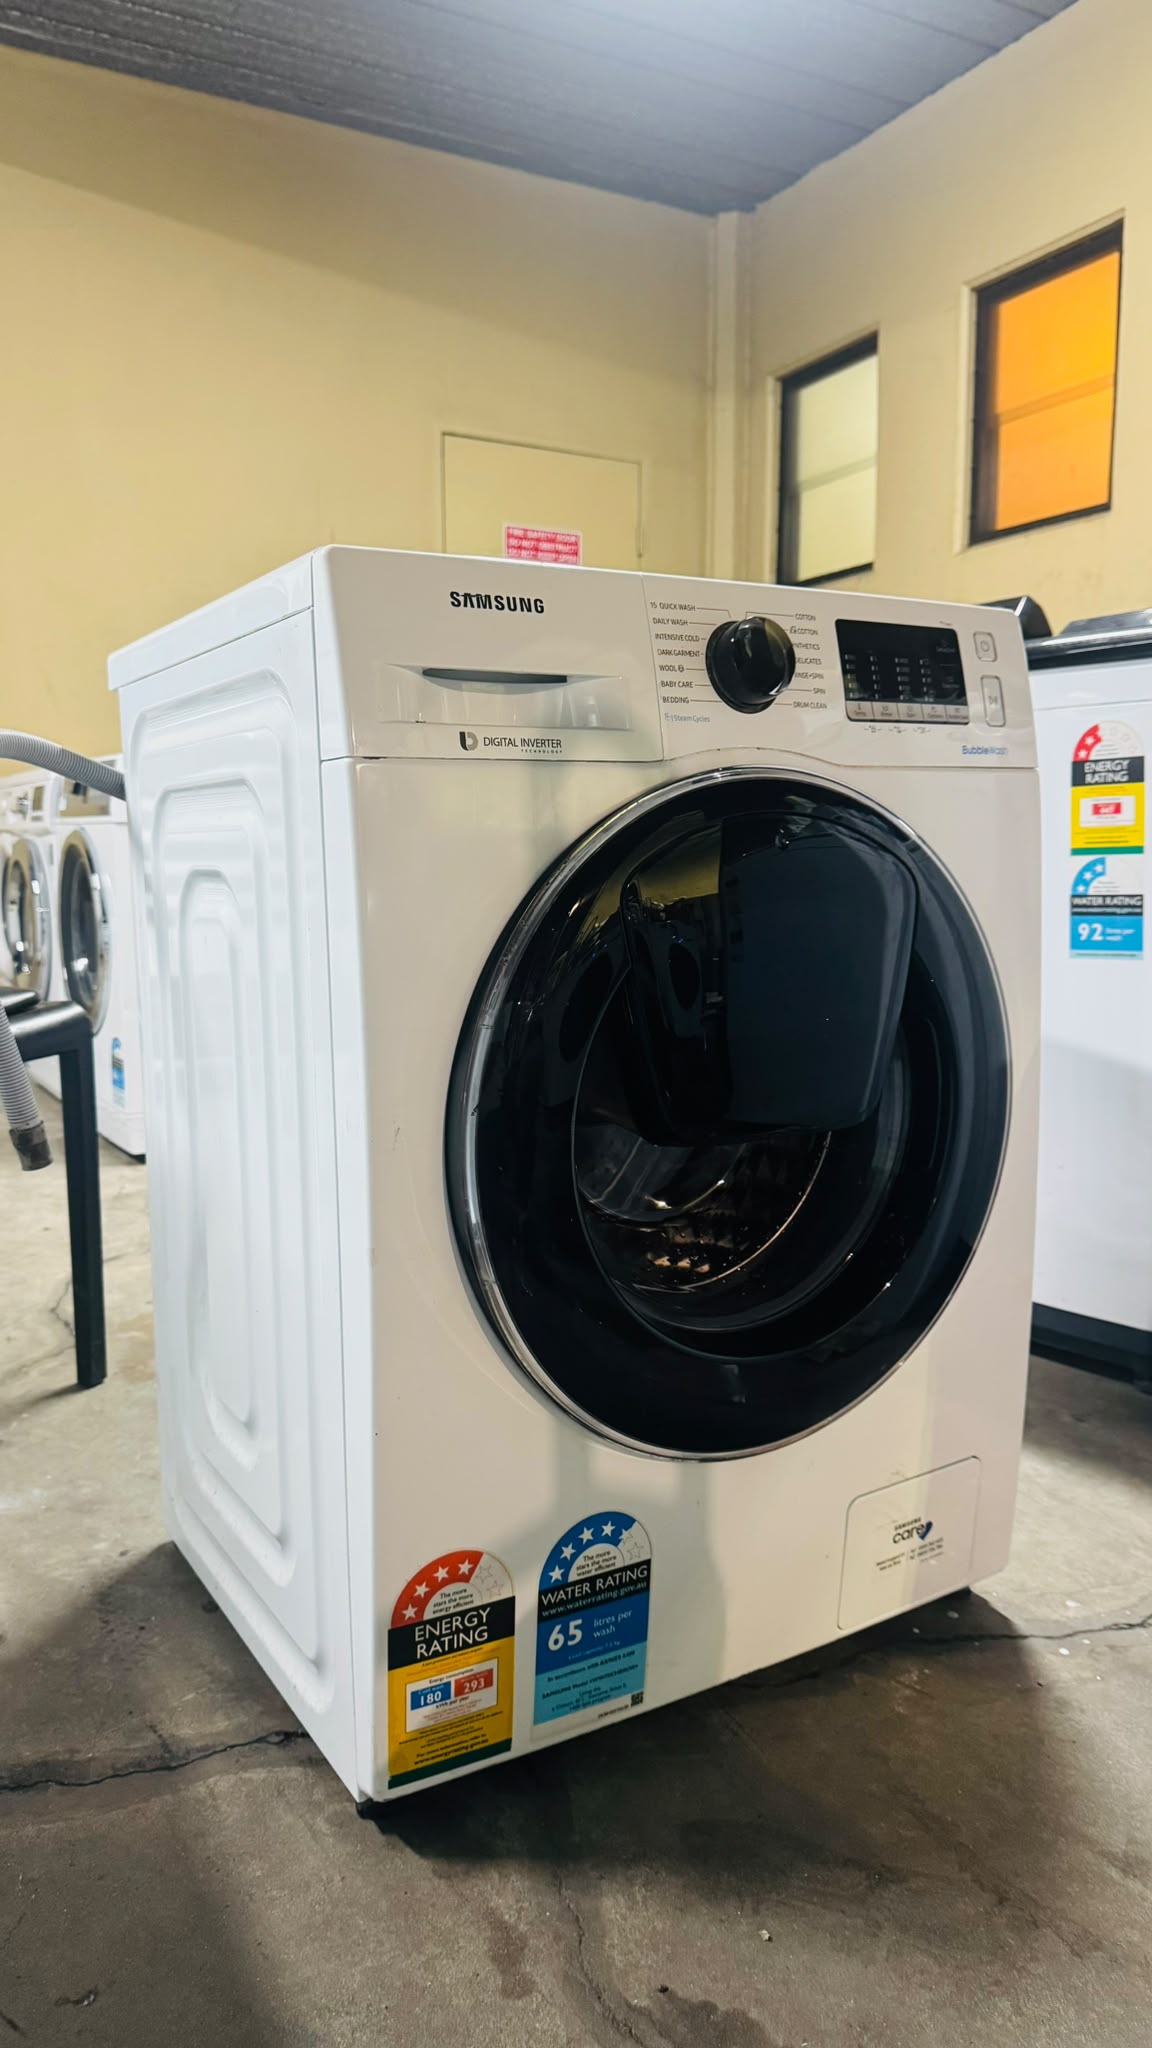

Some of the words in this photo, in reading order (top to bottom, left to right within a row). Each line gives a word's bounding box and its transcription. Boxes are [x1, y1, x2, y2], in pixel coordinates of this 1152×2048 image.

[450, 591, 545, 613] SAMSUNG
[795, 613, 817, 621] COTTON
[655, 633, 683, 641] INTENSIVE
[483, 737, 519, 748] DIGITAL
[520, 738, 563, 749] INVERTER
[1084, 759, 1130, 773] ENERGY
[1085, 771, 1129, 784] RATING
[1072, 896, 1104, 906] WATER
[1105, 896, 1143, 906] RATING
[1078, 923, 1104, 941] 92
[893, 1524, 926, 1543] care
[583, 1554, 595, 1562] The
[595, 1550, 611, 1559] more
[602, 1556, 617, 1565] more
[576, 1570, 593, 1578] water
[594, 1562, 616, 1573] efficient
[541, 1581, 592, 1606] WATER
[596, 1565, 649, 1592] RATING
[433, 1600, 447, 1608] stars
[459, 1593, 474, 1602] more
[440, 1591, 451, 1600] The
[452, 1588, 467, 1597] more
[542, 1581, 648, 1617] www.waterrating.gov.au
[432, 1605, 452, 1615] energy
[452, 1599, 475, 1609] efficient
[414, 1606, 491, 1642] ENERGY
[547, 1618, 584, 1651] 65
[593, 1614, 616, 1628] litres
[617, 1609, 632, 1623] per
[593, 1625, 616, 1638] wash
[417, 1626, 489, 1660] RATING
[463, 1677, 486, 1694] 293
[420, 1691, 442, 1706] 180
